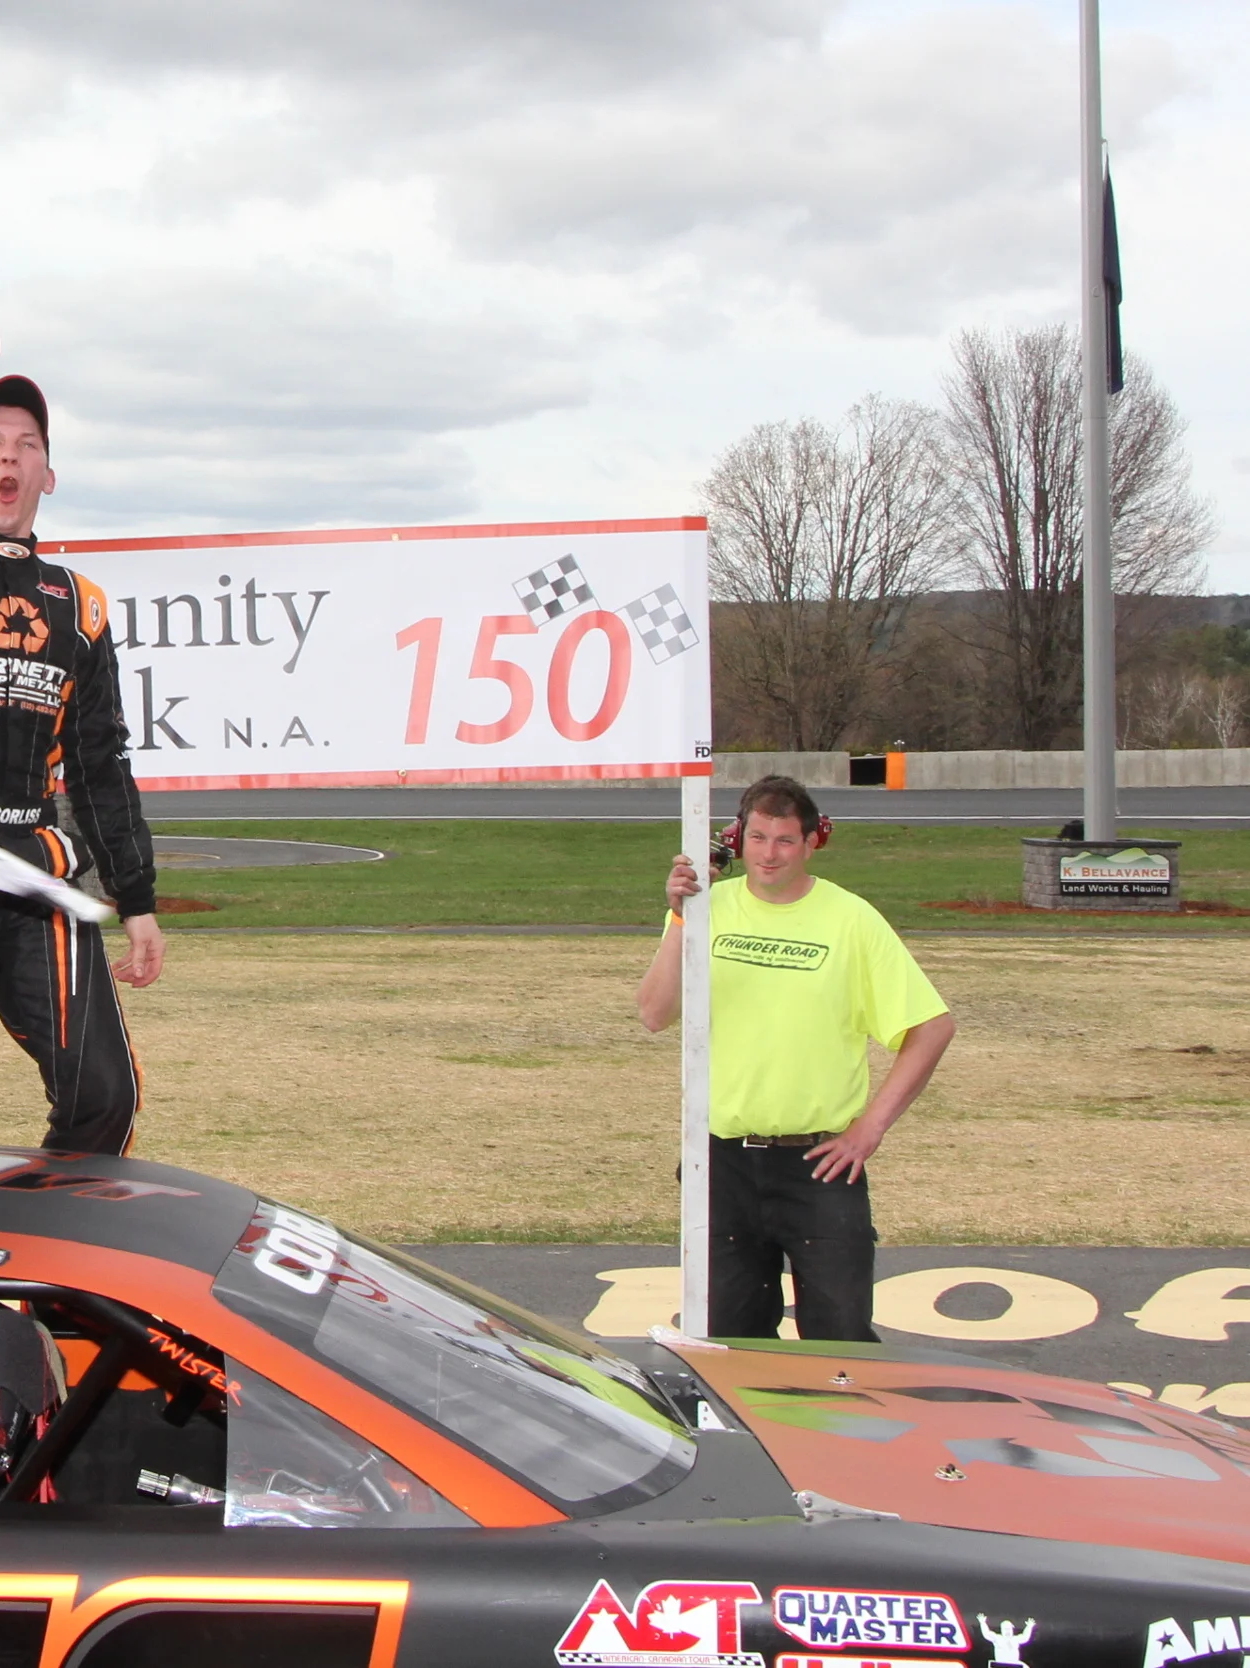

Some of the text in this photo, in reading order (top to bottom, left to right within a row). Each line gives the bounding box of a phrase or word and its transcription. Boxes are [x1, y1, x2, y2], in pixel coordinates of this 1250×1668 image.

[395, 609, 632, 746] 150
[224, 715, 330, 750] N.A.
[1062, 884, 1085, 892] Land
[1088, 884, 1119, 893] Works
[1132, 885, 1168, 894] Hauling
[1063, 867, 1167, 877] K. BELLAVANCE
[718, 938, 780, 954] THUNDER
[781, 945, 819, 958] ROAD
[147, 1327, 242, 1407] TWISTER
[556, 1581, 761, 1653] ACT
[779, 1592, 949, 1626] QUARTER
[809, 1617, 958, 1645] MASTER
